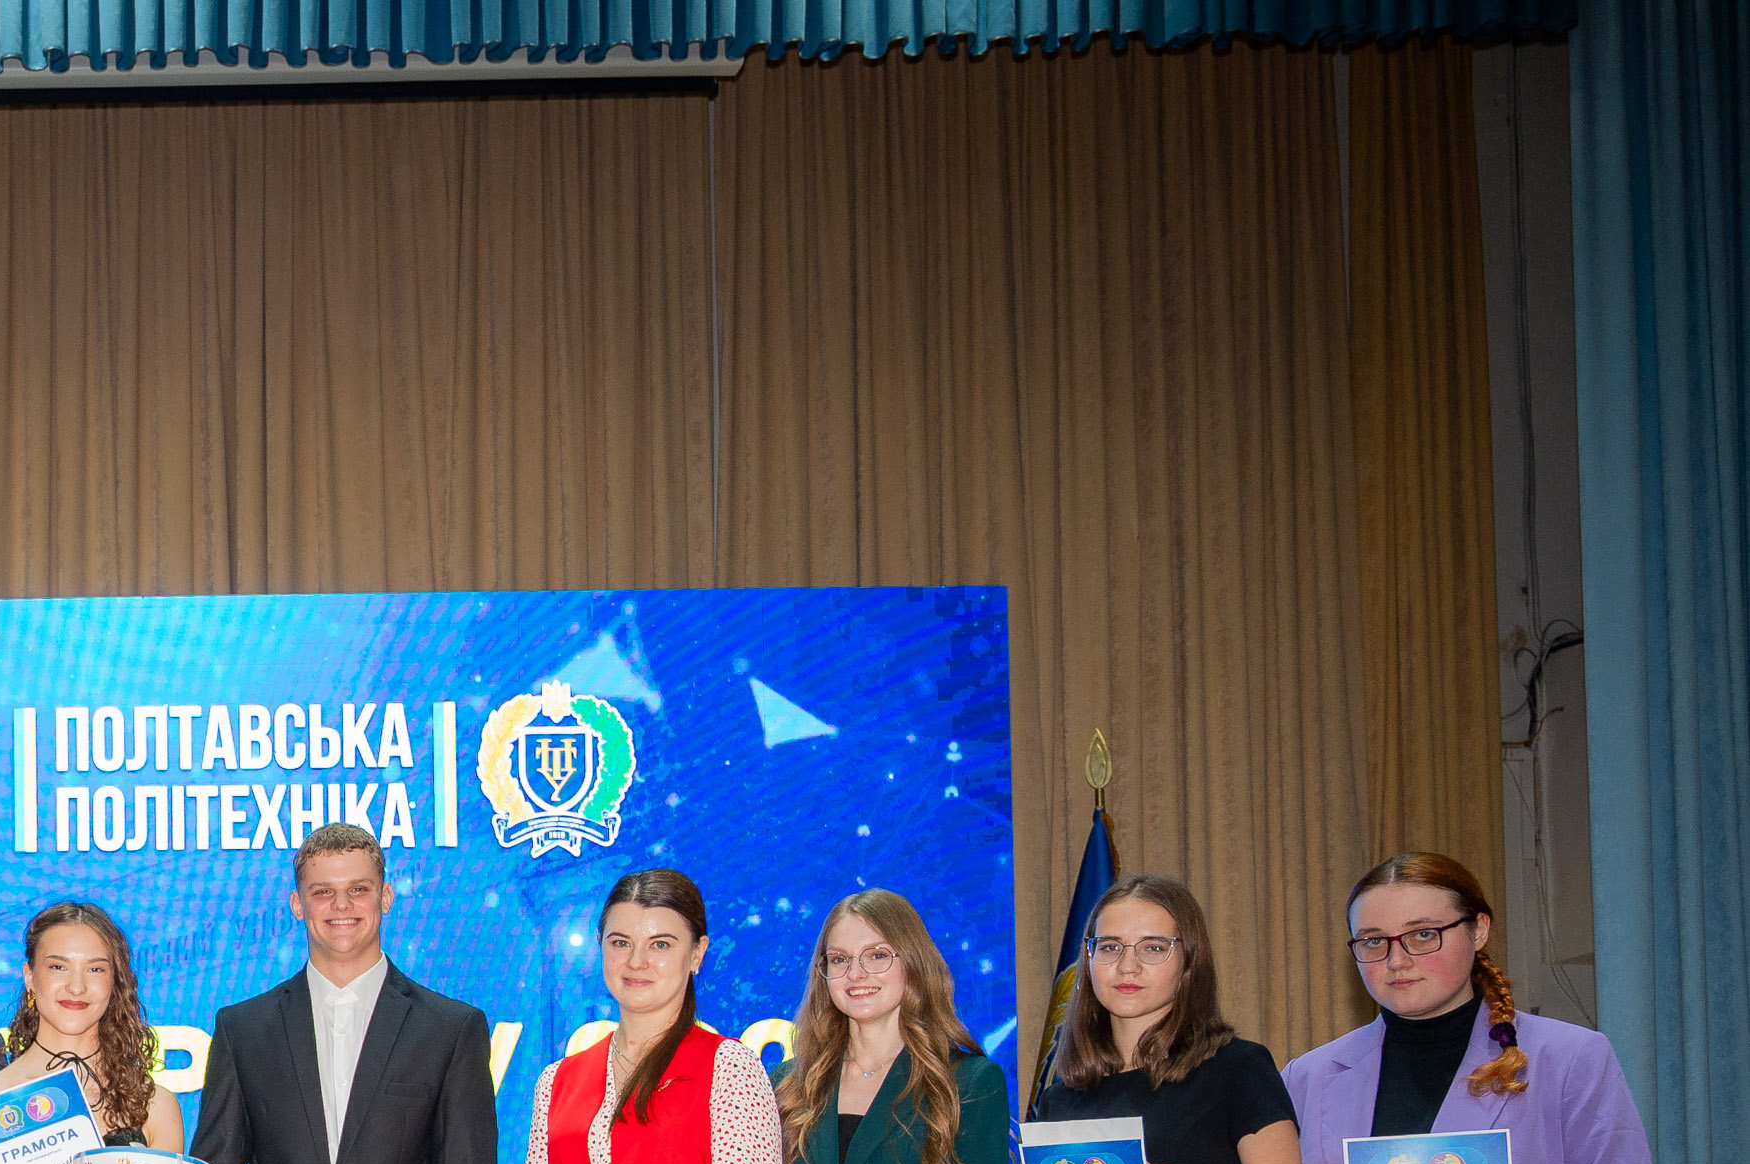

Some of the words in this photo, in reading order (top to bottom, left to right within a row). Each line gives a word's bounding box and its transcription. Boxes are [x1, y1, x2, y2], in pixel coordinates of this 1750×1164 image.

[56, 703, 414, 772] ПОЛТАВСЬКА
[56, 783, 416, 851] ПОЛІТЕХНІКА
[1, 1129, 78, 1163] ГРАМОТА
